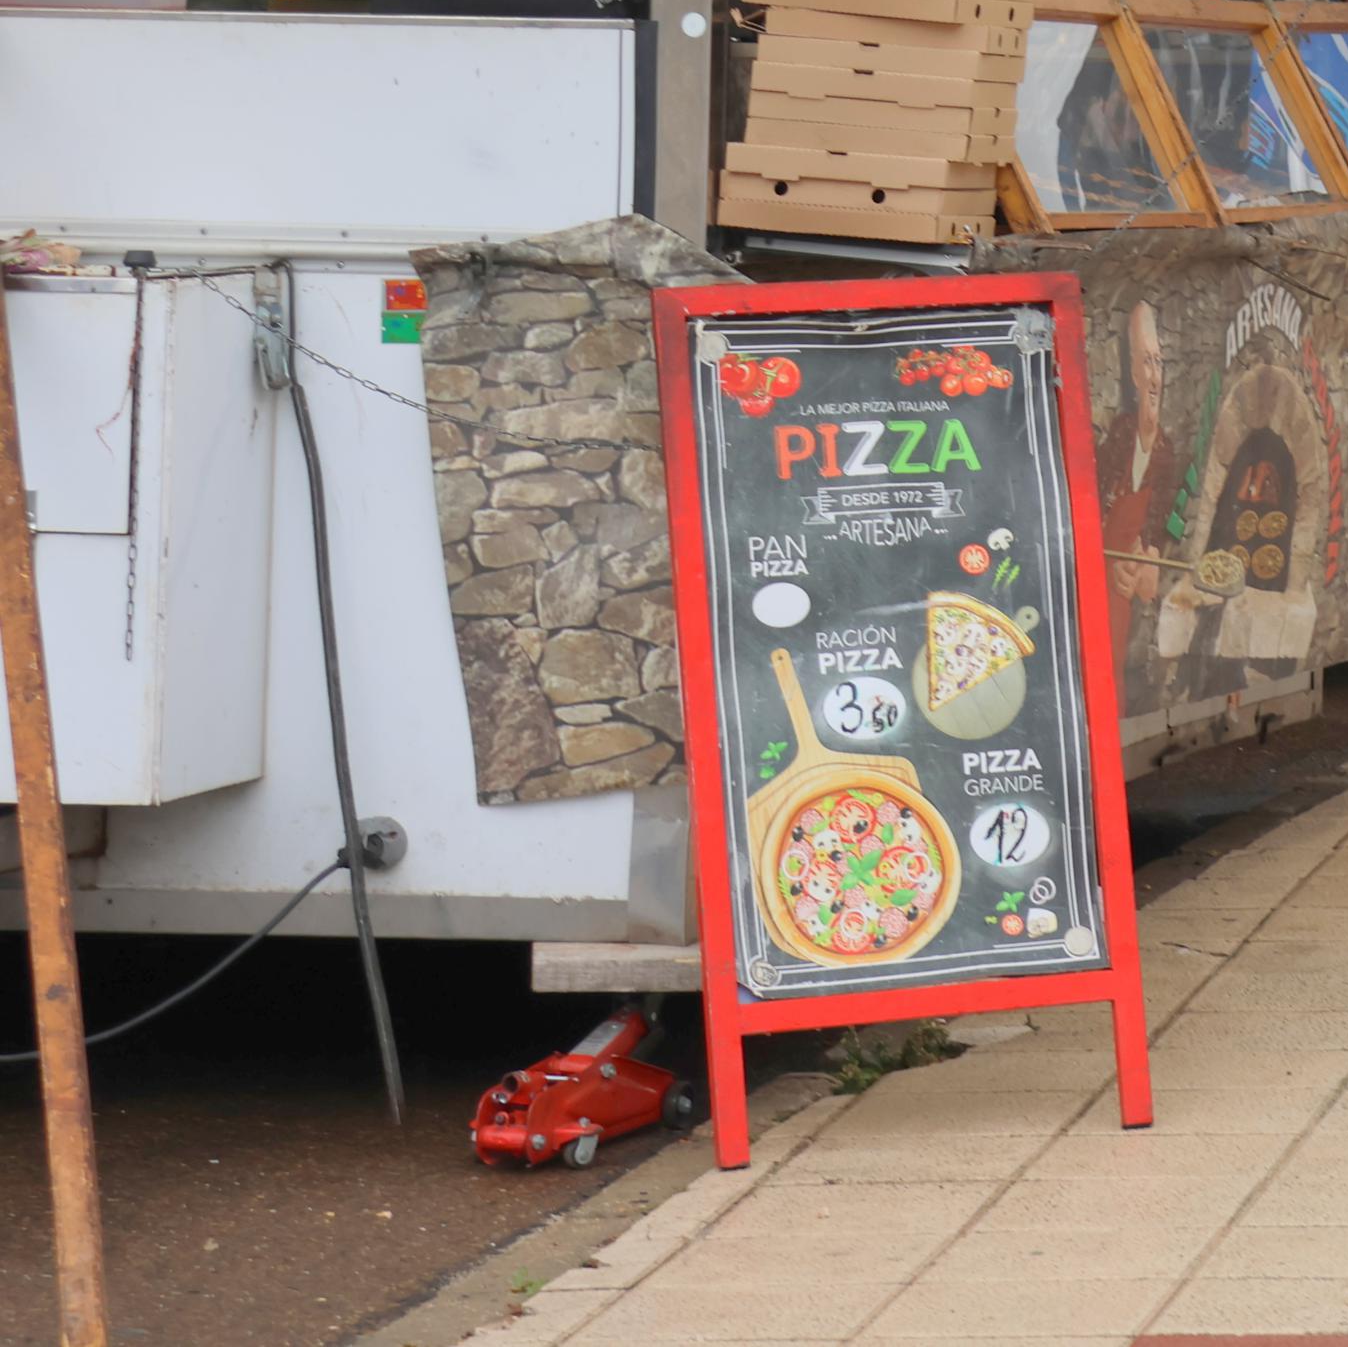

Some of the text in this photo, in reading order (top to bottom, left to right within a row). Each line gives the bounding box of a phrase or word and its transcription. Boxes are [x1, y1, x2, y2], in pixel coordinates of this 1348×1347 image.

[1225, 283, 1302, 369] ARTESANA
[799, 400, 951, 416] LA MEJOR PIZZA ITALIANA
[773, 418, 982, 480] PIZZA
[841, 490, 924, 508] DESDE 1972
[748, 534, 808, 561] PAN
[749, 559, 809, 579] PIZZA
[816, 625, 896, 648] RACIÓN
[818, 647, 904, 675] PIZZA
[962, 748, 1043, 776] PIZZA
[963, 773, 1045, 797] GRANDE
[983, 805, 1029, 864] 12
